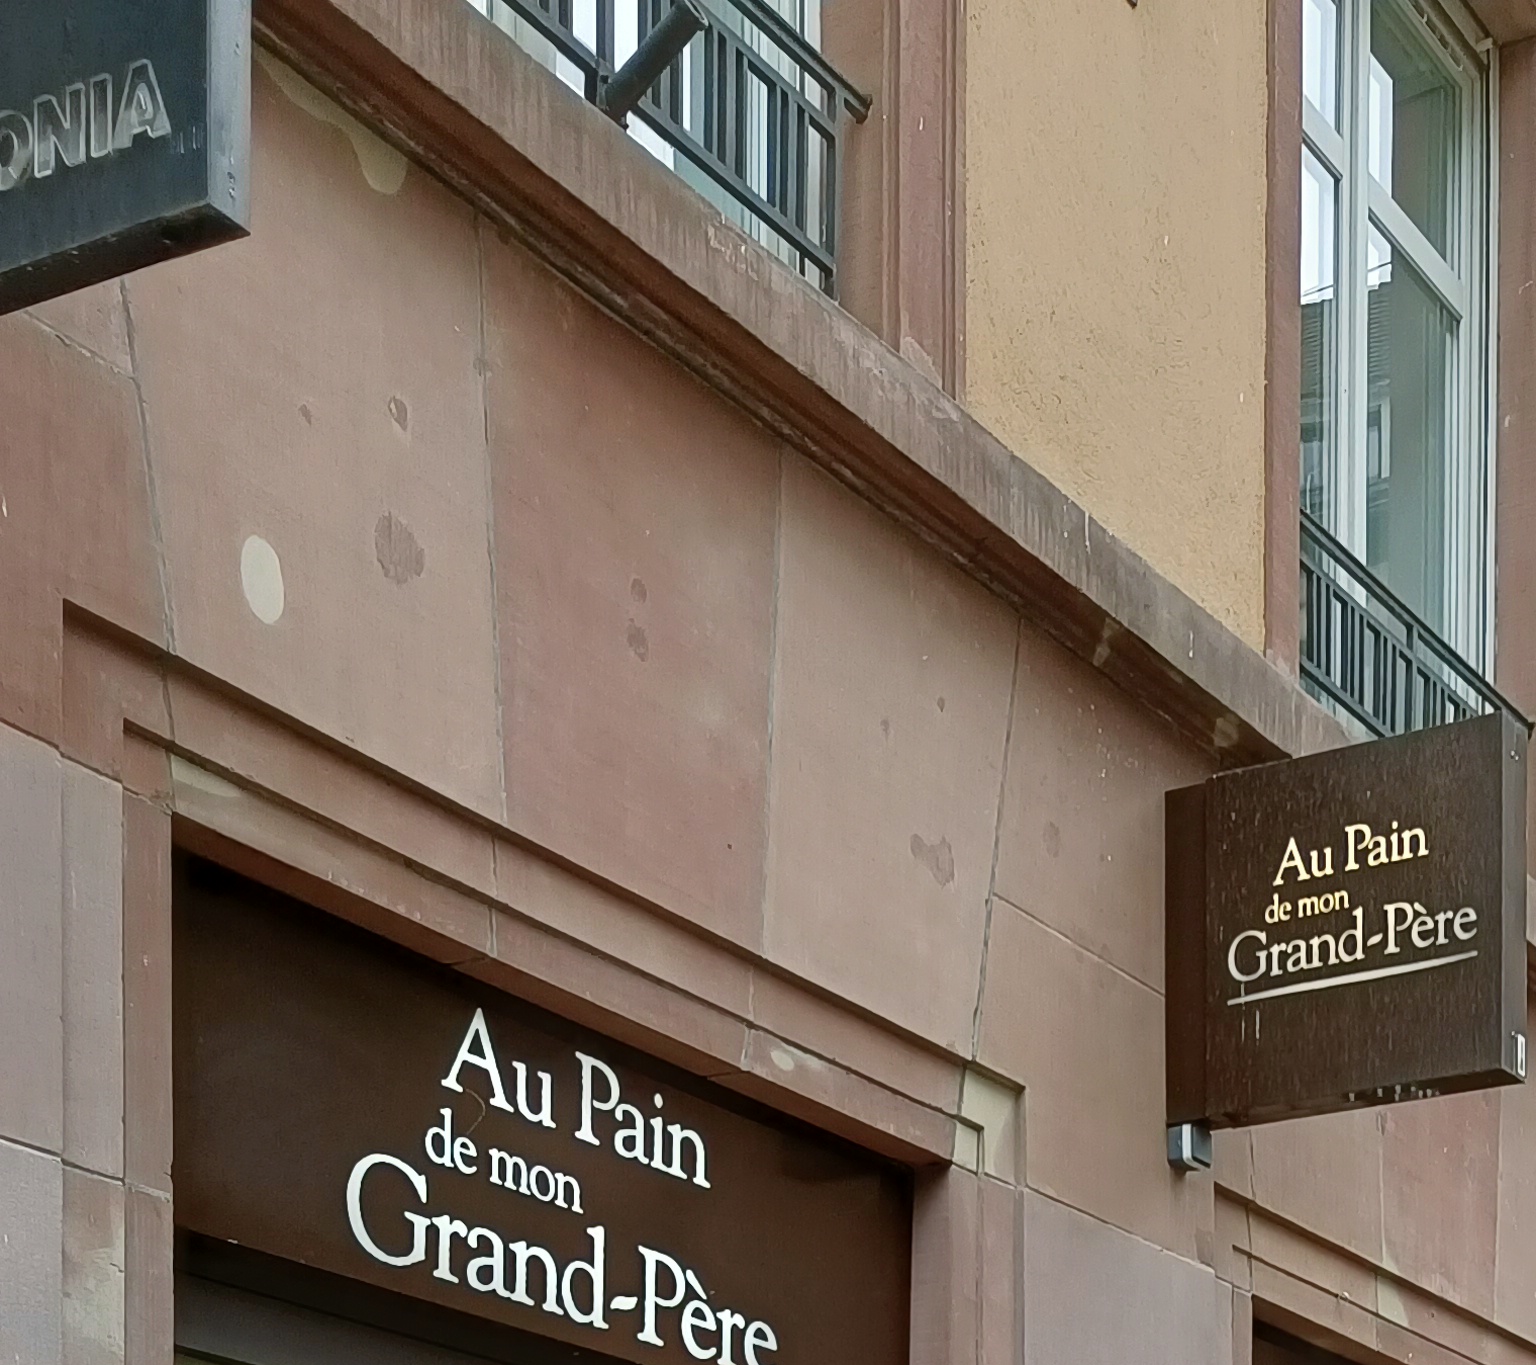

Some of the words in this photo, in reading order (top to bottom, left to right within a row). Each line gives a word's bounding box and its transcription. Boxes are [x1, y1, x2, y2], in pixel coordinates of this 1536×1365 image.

[1273, 836, 1333, 886] Au
[1345, 821, 1428, 872] Pain
[1228, 901, 1478, 983] Grand-Père
[1265, 893, 1292, 924] de
[1298, 889, 1350, 919] mon
[441, 1007, 556, 1129] Au
[574, 1050, 711, 1189] Pain
[425, 1107, 478, 1175] de
[489, 1146, 585, 1214] mon
